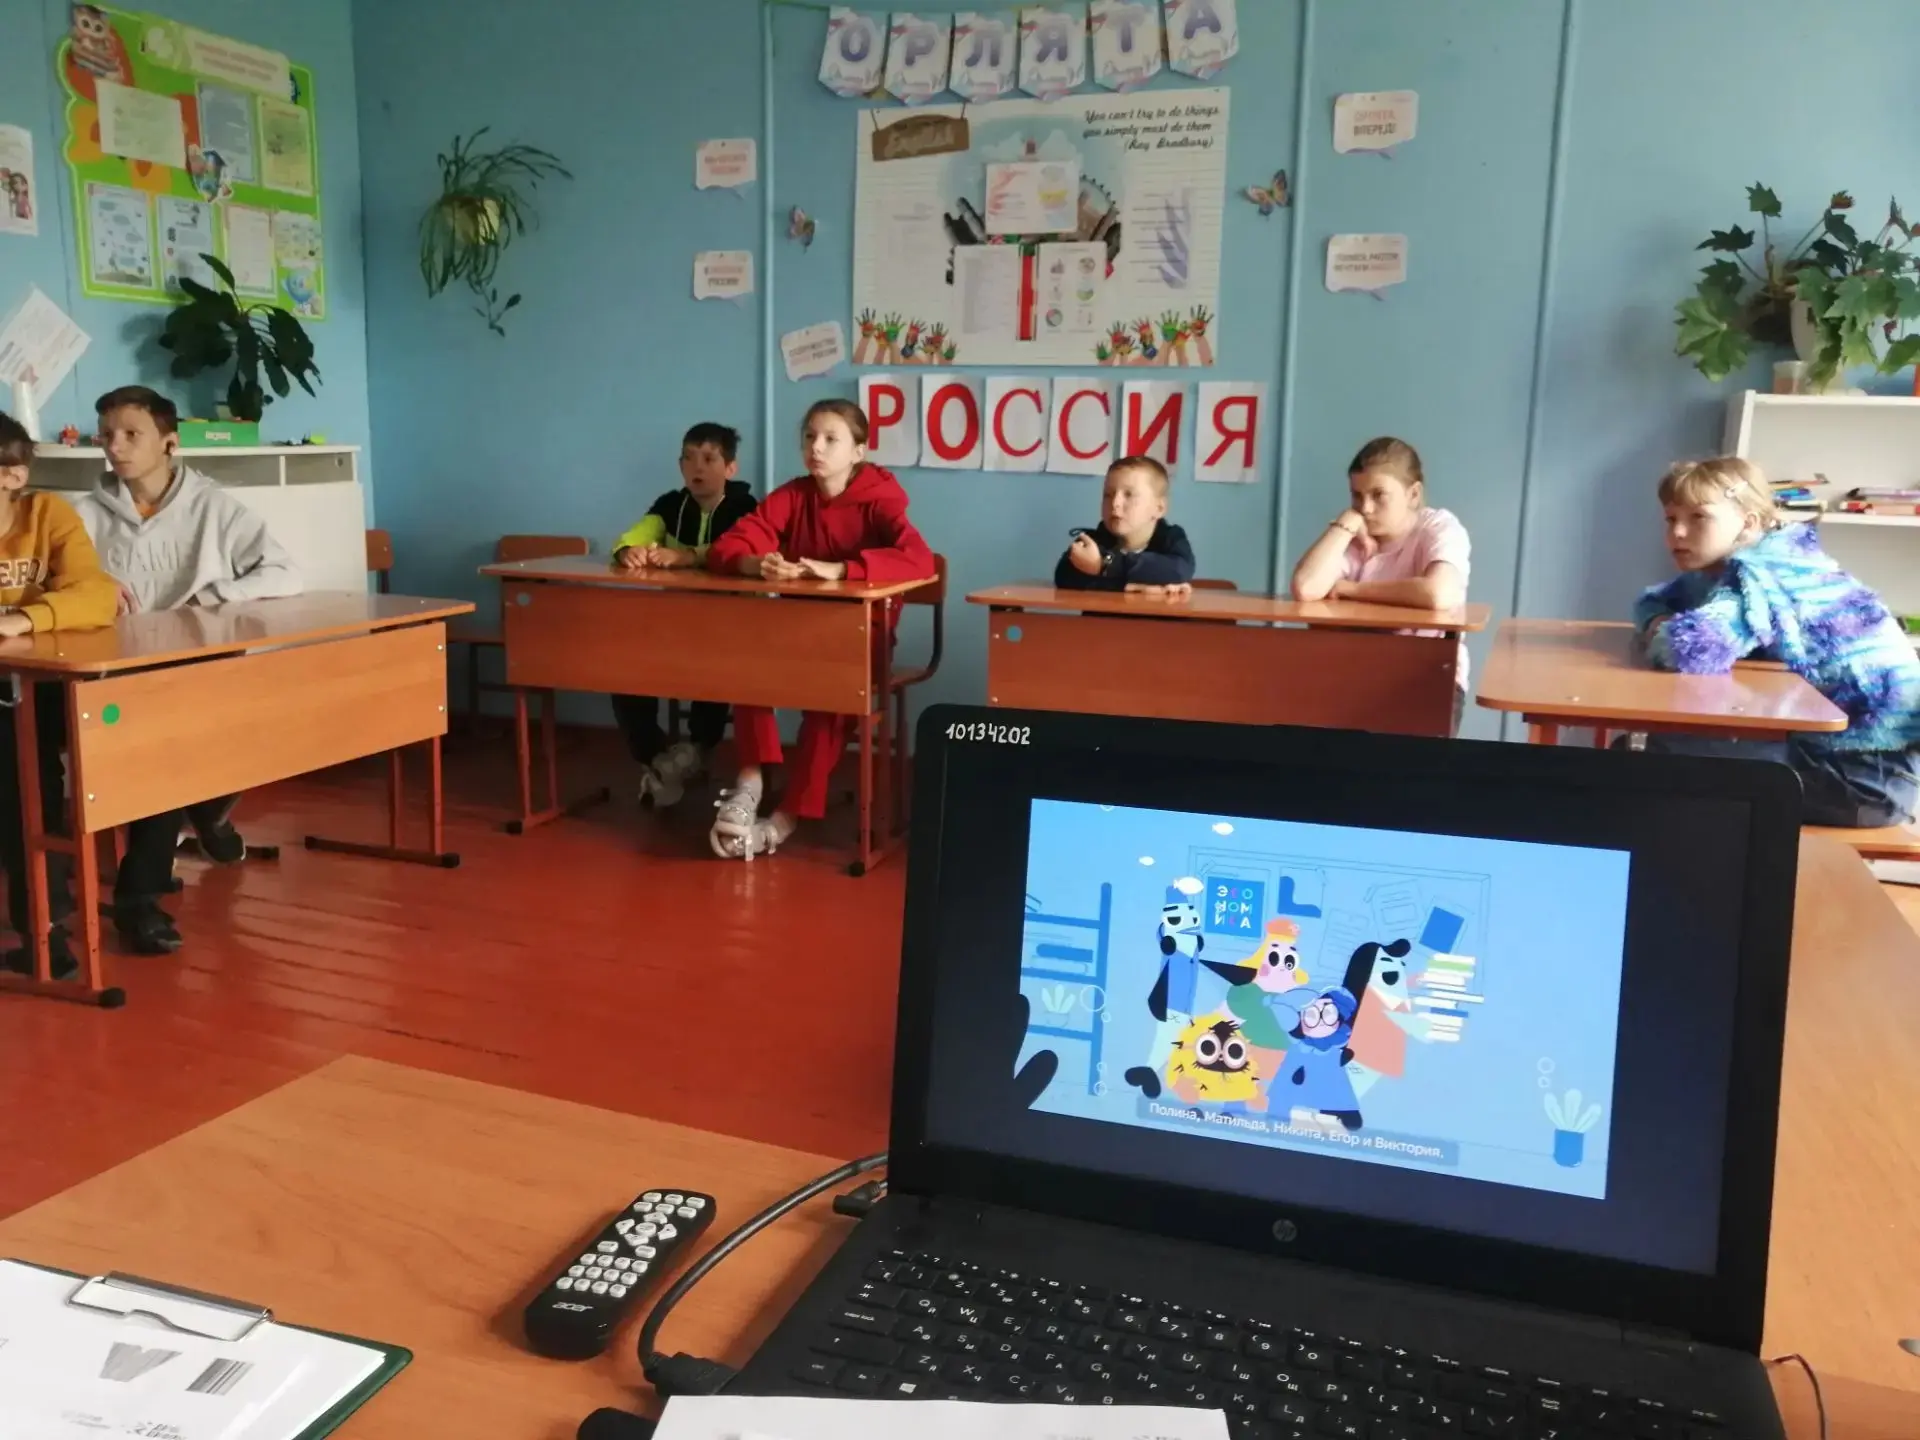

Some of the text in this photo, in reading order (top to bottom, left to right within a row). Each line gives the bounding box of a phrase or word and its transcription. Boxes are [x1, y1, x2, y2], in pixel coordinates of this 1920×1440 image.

[839, 0, 1222, 68] ОРЛЯТА
[1085, 110, 1106, 124] You
[1137, 108, 1154, 120] try
[1156, 108, 1166, 118] to
[1169, 106, 1182, 117] do
[1104, 124, 1138, 138] simply
[1141, 123, 1169, 134] must
[1170, 122, 1183, 133] do
[1185, 122, 1213, 132] them
[868, 383, 1259, 469] РОССИЯ
[945, 722, 1031, 745] 10134202
[1149, 1102, 1444, 1158] Полина, Матильда, Никита, Егор и Виктория.
[552, 1301, 594, 1312] acer
